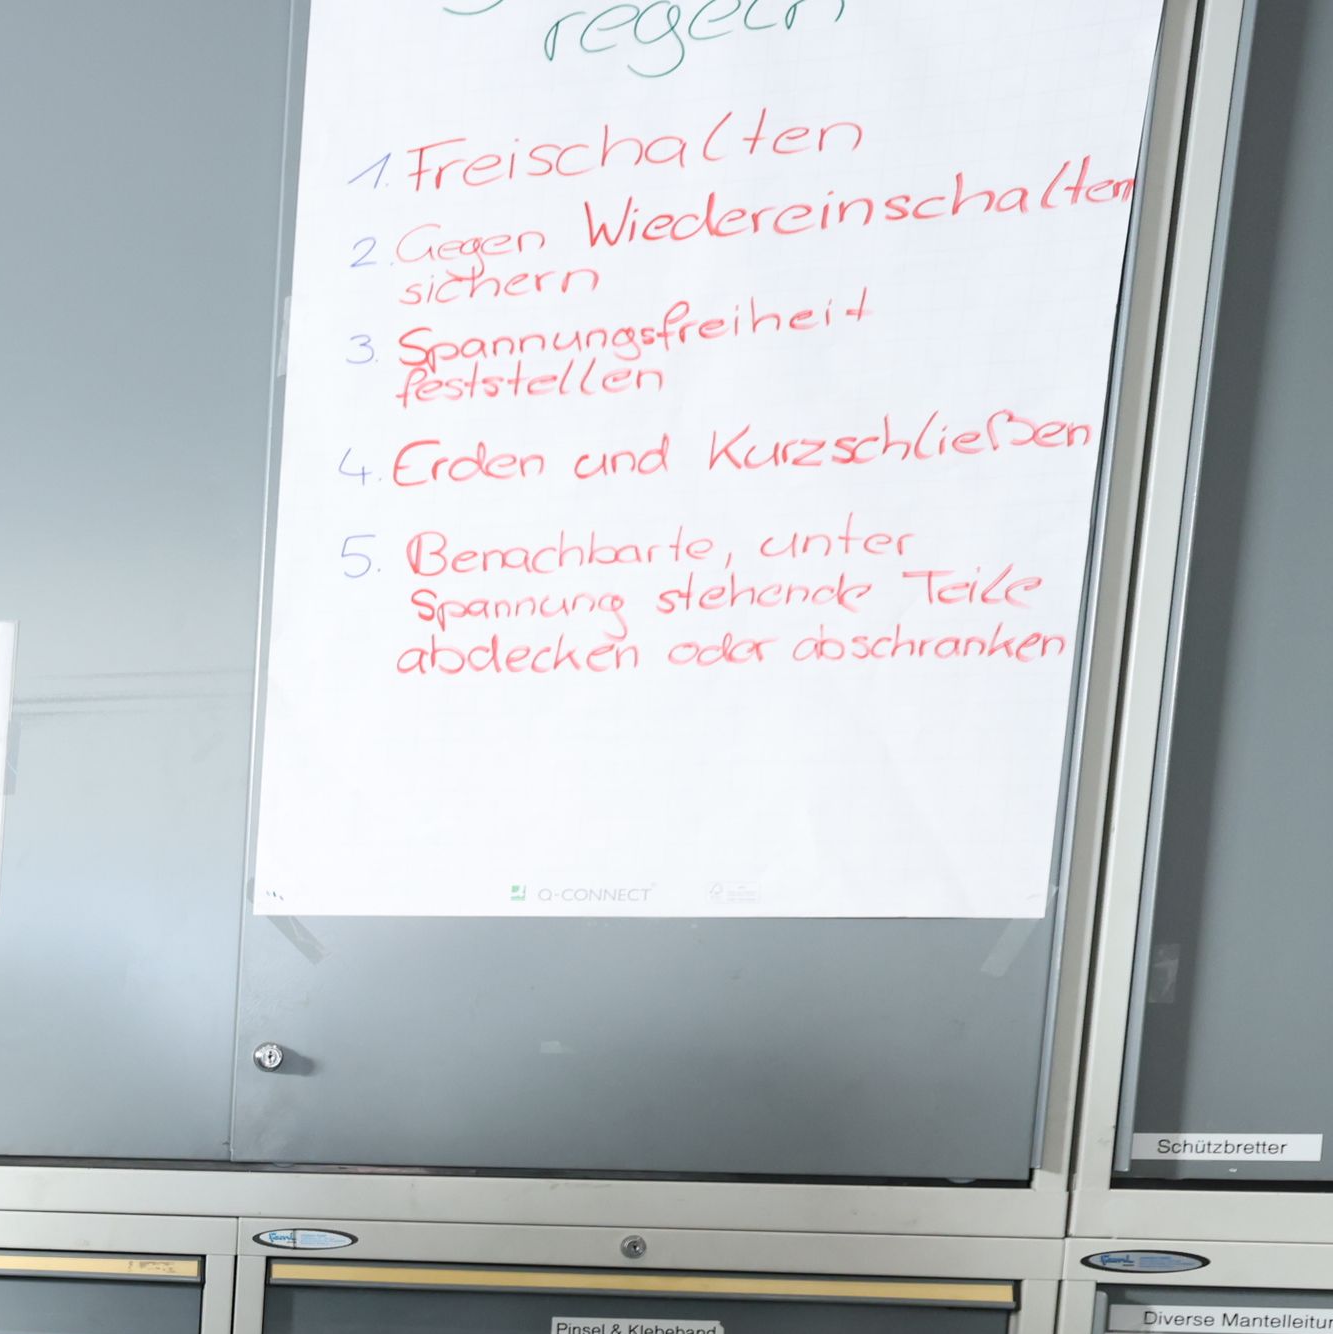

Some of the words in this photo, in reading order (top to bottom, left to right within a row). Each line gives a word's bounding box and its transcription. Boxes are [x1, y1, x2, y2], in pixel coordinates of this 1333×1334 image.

[348, 152, 390, 190] 1.
[406, 108, 863, 192] Freischalten
[396, 222, 546, 270] Gegen
[584, 156, 1135, 249] Wiedereinschalten
[399, 264, 599, 305] sichern
[398, 286, 871, 370] Spannungsfreiheit
[395, 361, 664, 402] feststellen
[338, 447, 383, 486] 4.
[392, 439, 545, 488] Erden
[574, 433, 668, 481] und
[708, 409, 1092, 472] Kurzschließen
[340, 534, 381, 578] 5.
[759, 511, 917, 563] unter
[410, 589, 625, 640] Spannung
[656, 574, 872, 616] stehende
[903, 563, 1042, 608] Teile
[396, 634, 639, 675] abdecken
[667, 634, 774, 666] oder
[792, 622, 1065, 661] abschranken
[1157, 1138, 1288, 1157] Schützbretter
[1144, 1311, 1215, 1327] Diverse
